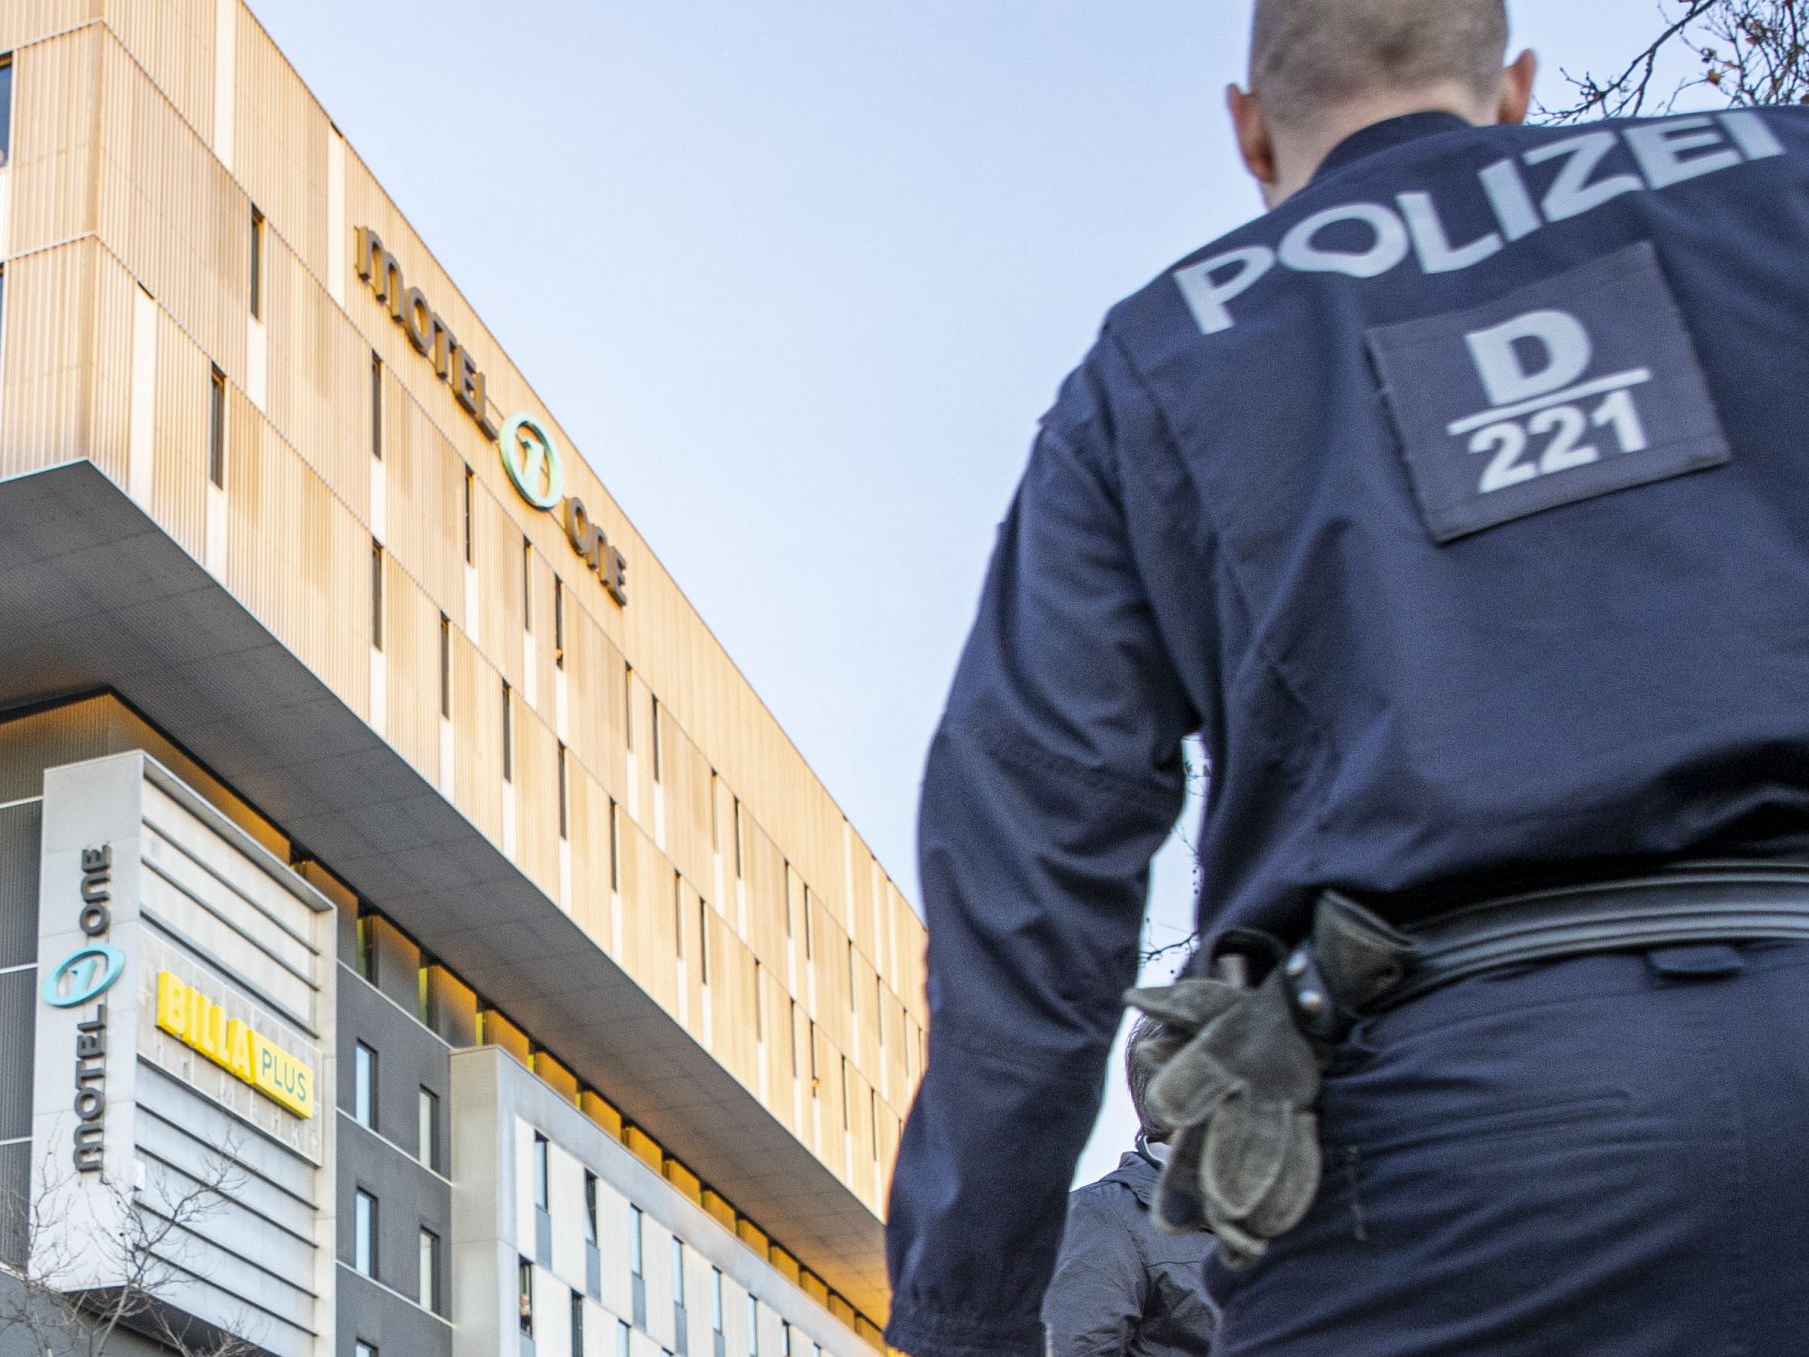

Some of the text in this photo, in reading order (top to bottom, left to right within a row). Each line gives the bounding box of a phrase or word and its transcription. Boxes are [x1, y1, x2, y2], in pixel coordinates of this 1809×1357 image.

[1172, 109, 1787, 336] POLIZEI
[1464, 309, 1591, 408] D
[1468, 389, 1650, 495] 221
[157, 969, 307, 1102] BILLA PLUS
